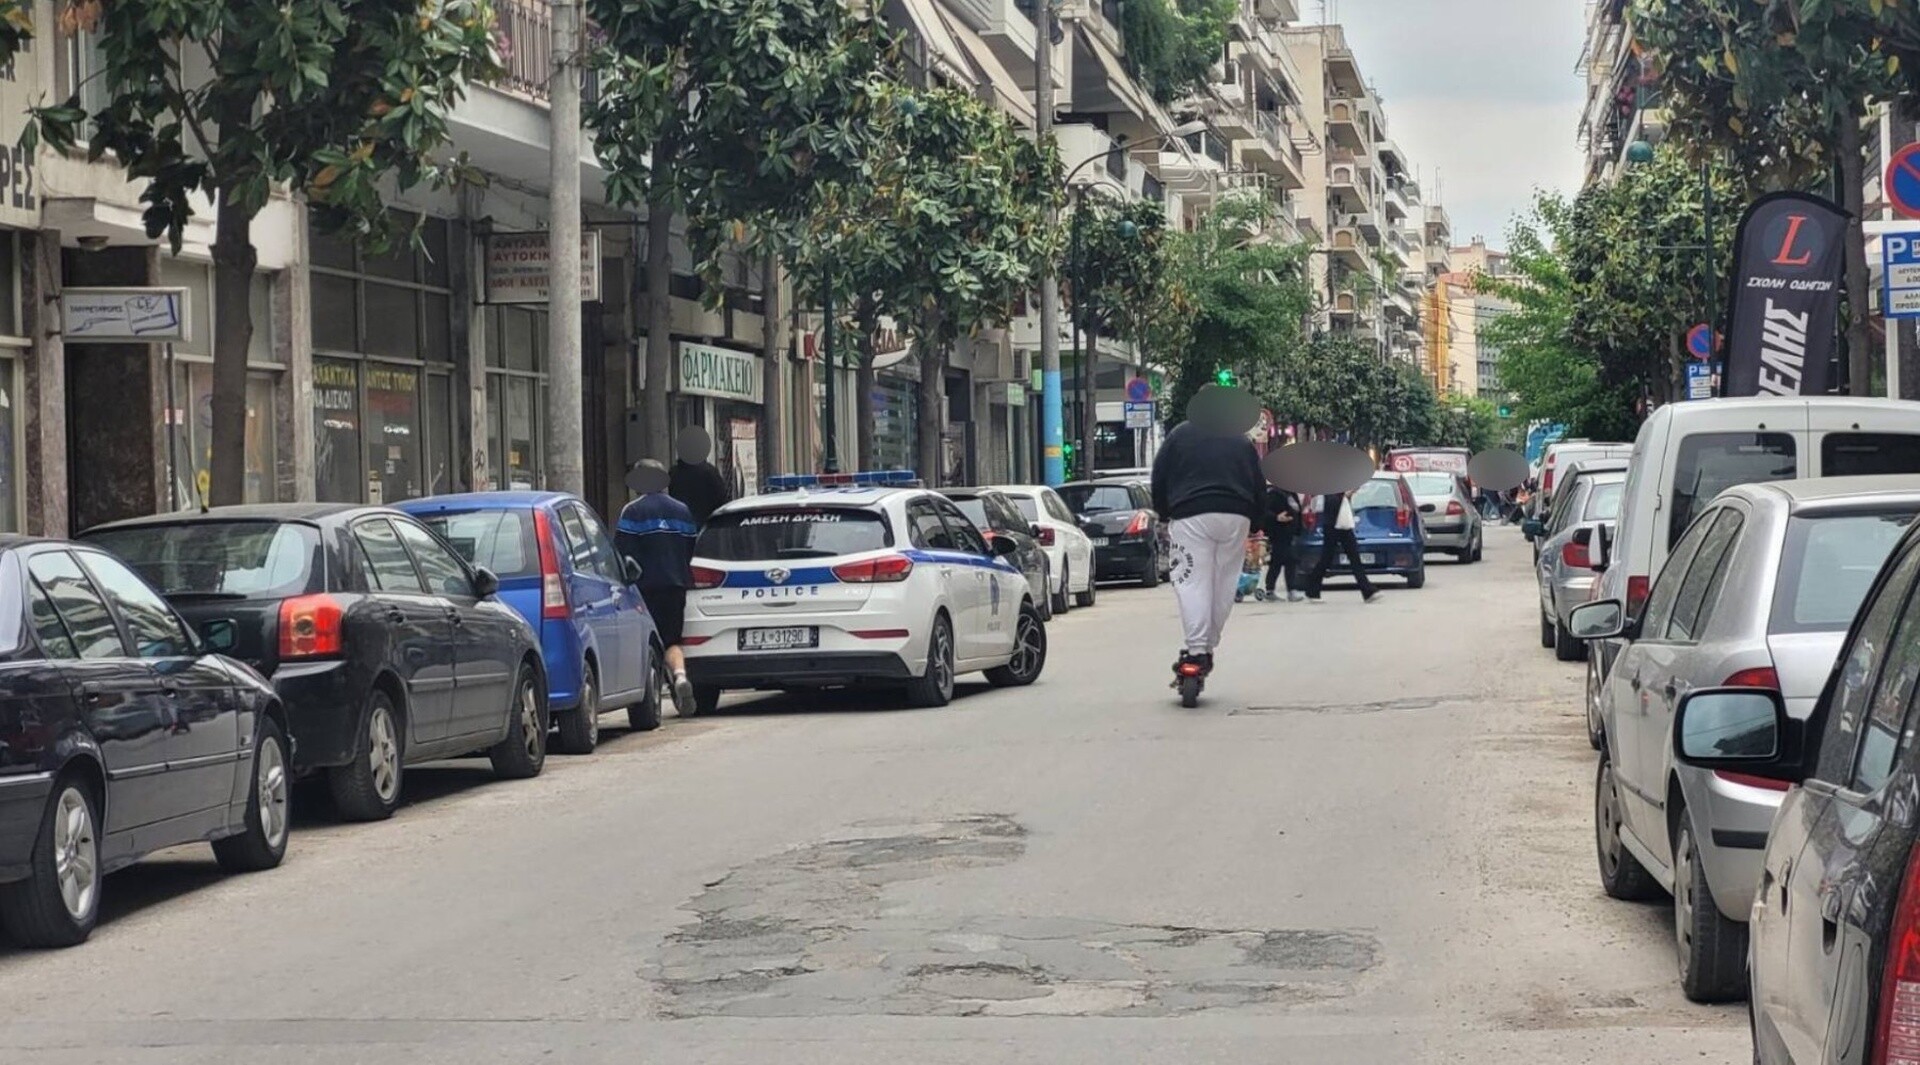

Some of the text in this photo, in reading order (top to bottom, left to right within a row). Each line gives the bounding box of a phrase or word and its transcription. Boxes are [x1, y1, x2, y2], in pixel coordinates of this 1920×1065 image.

[1770, 215, 1811, 265] L
[1887, 237, 1907, 263] P
[1747, 277, 1832, 291] ΣΧΟΛΗ ΟΔΗΓΩΝ
[682, 347, 753, 396] ΦΑΡΜΑΚΕΙΟ
[1689, 365, 1698, 377] P
[740, 514, 841, 526] ΑΜΕΣΗ ΔΡΑΣΗ
[741, 585, 819, 599] POLICE
